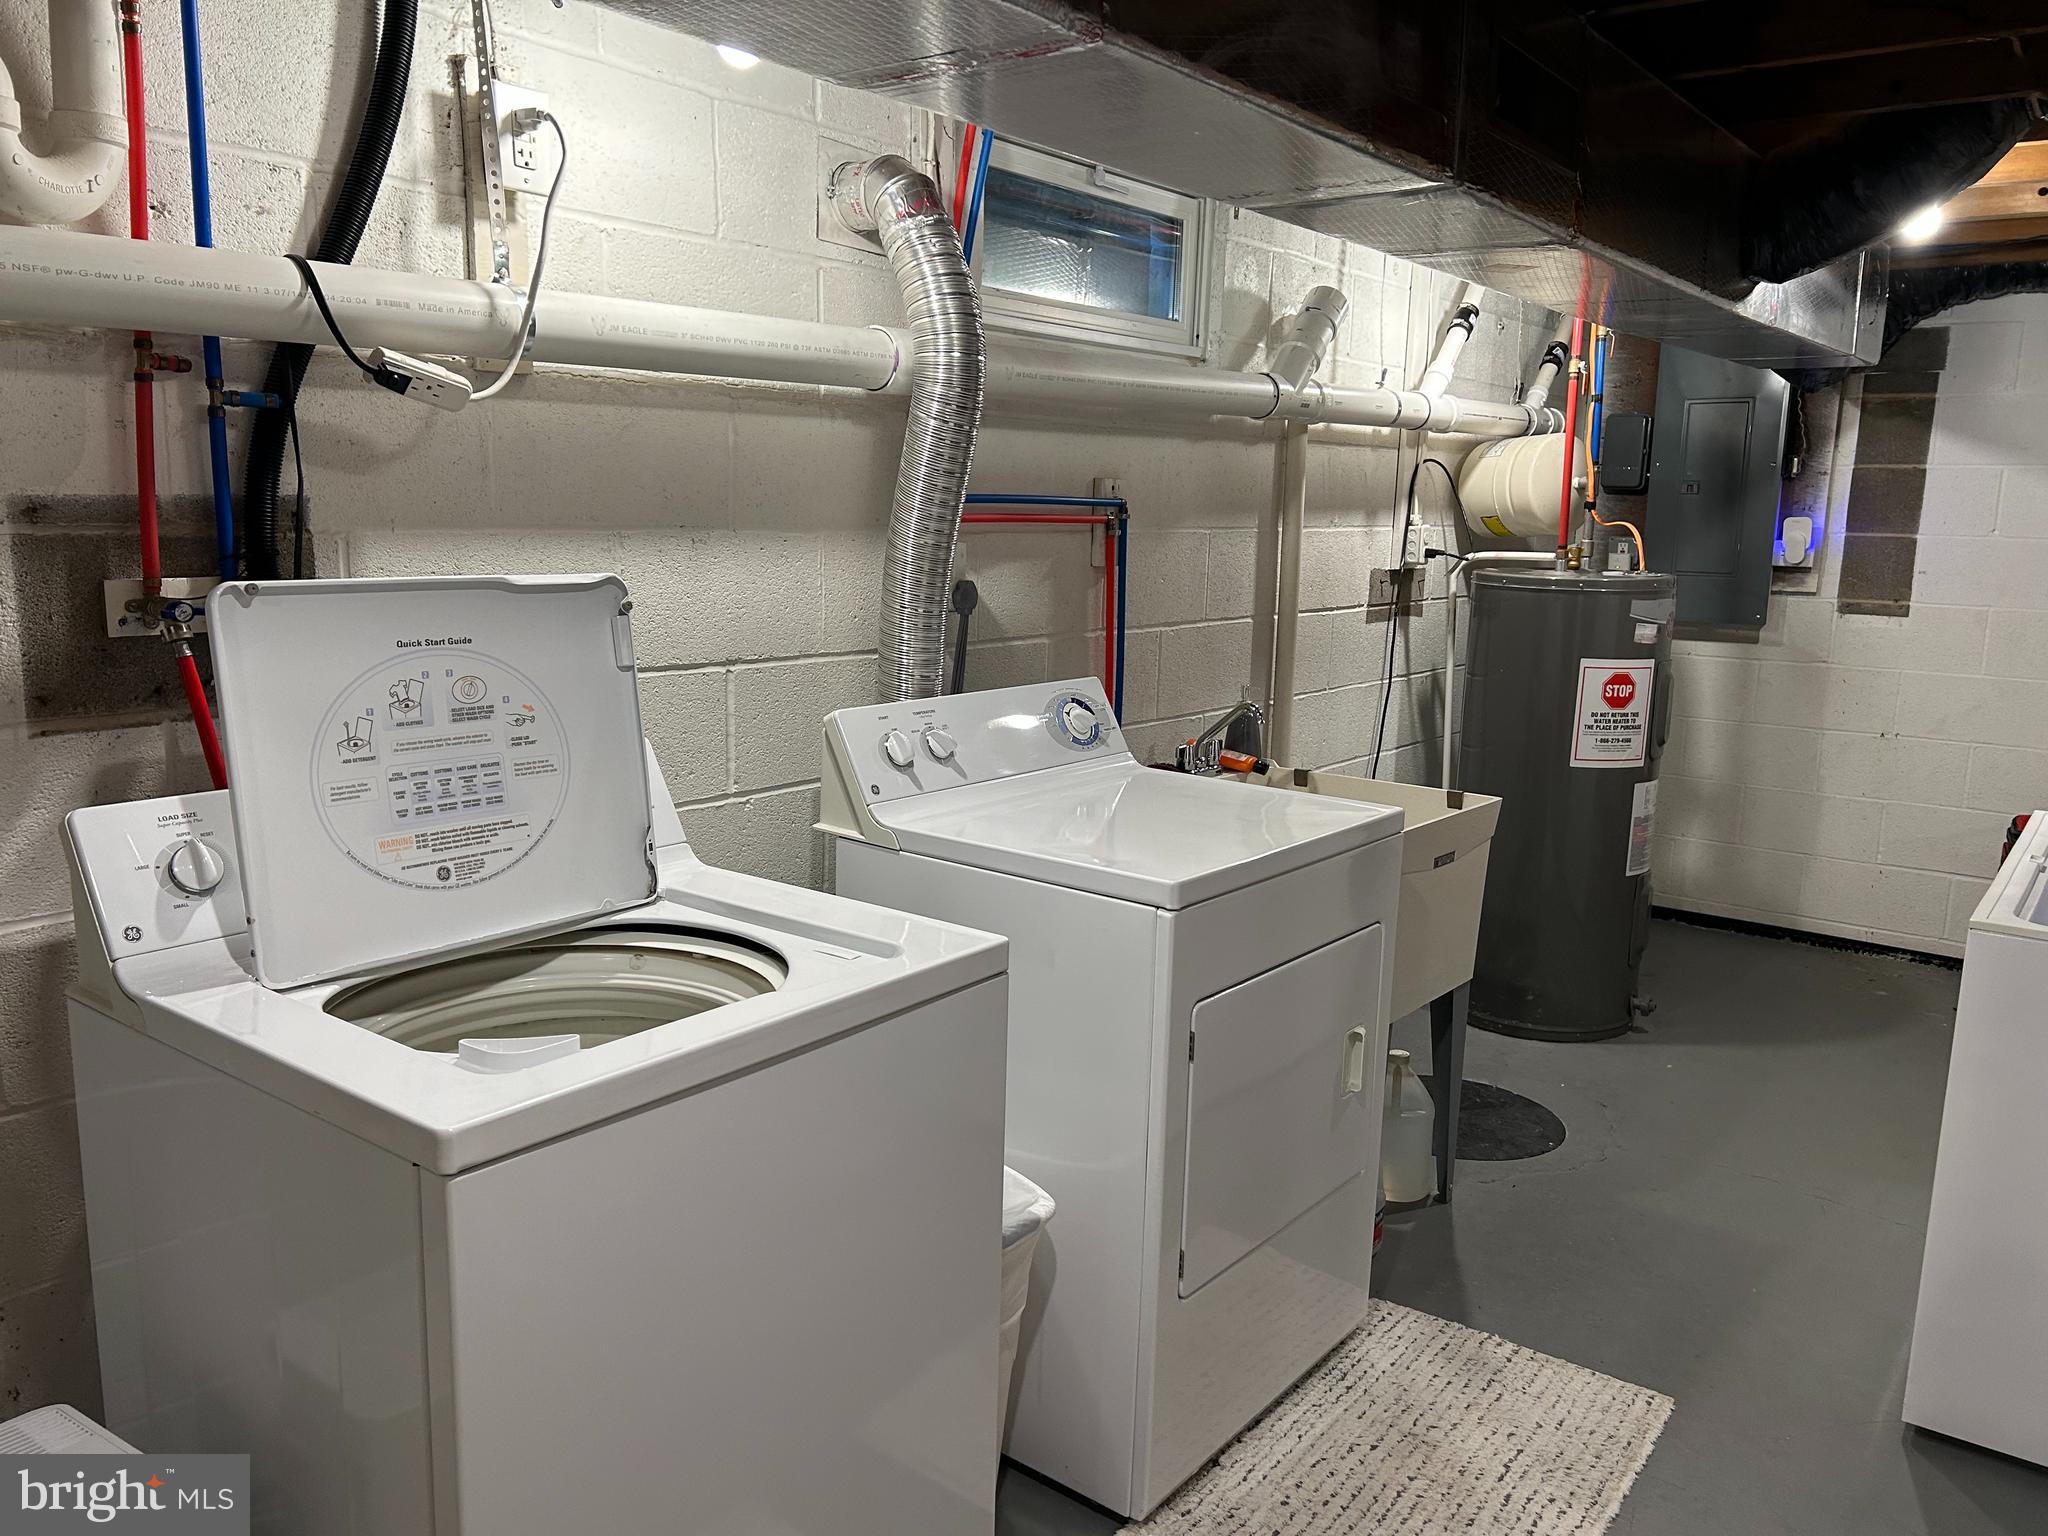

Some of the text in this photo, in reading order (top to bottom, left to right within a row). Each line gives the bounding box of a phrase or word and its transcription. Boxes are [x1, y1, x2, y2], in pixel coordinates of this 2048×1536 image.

[39, 176, 84, 194] CHARLOTTE
[56, 267, 118, 281] pw-G-dwv
[154, 276, 185, 287] Code
[189, 281, 219, 290] JM90
[225, 283, 241, 292] ME
[418, 302, 444, 313] Made
[446, 304, 454, 313] in
[457, 308, 493, 318] America
[609, 324, 620, 332] JM
[622, 325, 648, 336] EAGLE
[715, 335, 732, 344] DWV
[852, 350, 868, 358] ASTM
[396, 636, 473, 649] Quick Start Guide
[1605, 684, 1633, 697] STOP
[157, 811, 198, 822] LOAD SIZE
[378, 836, 414, 850] WARNING
